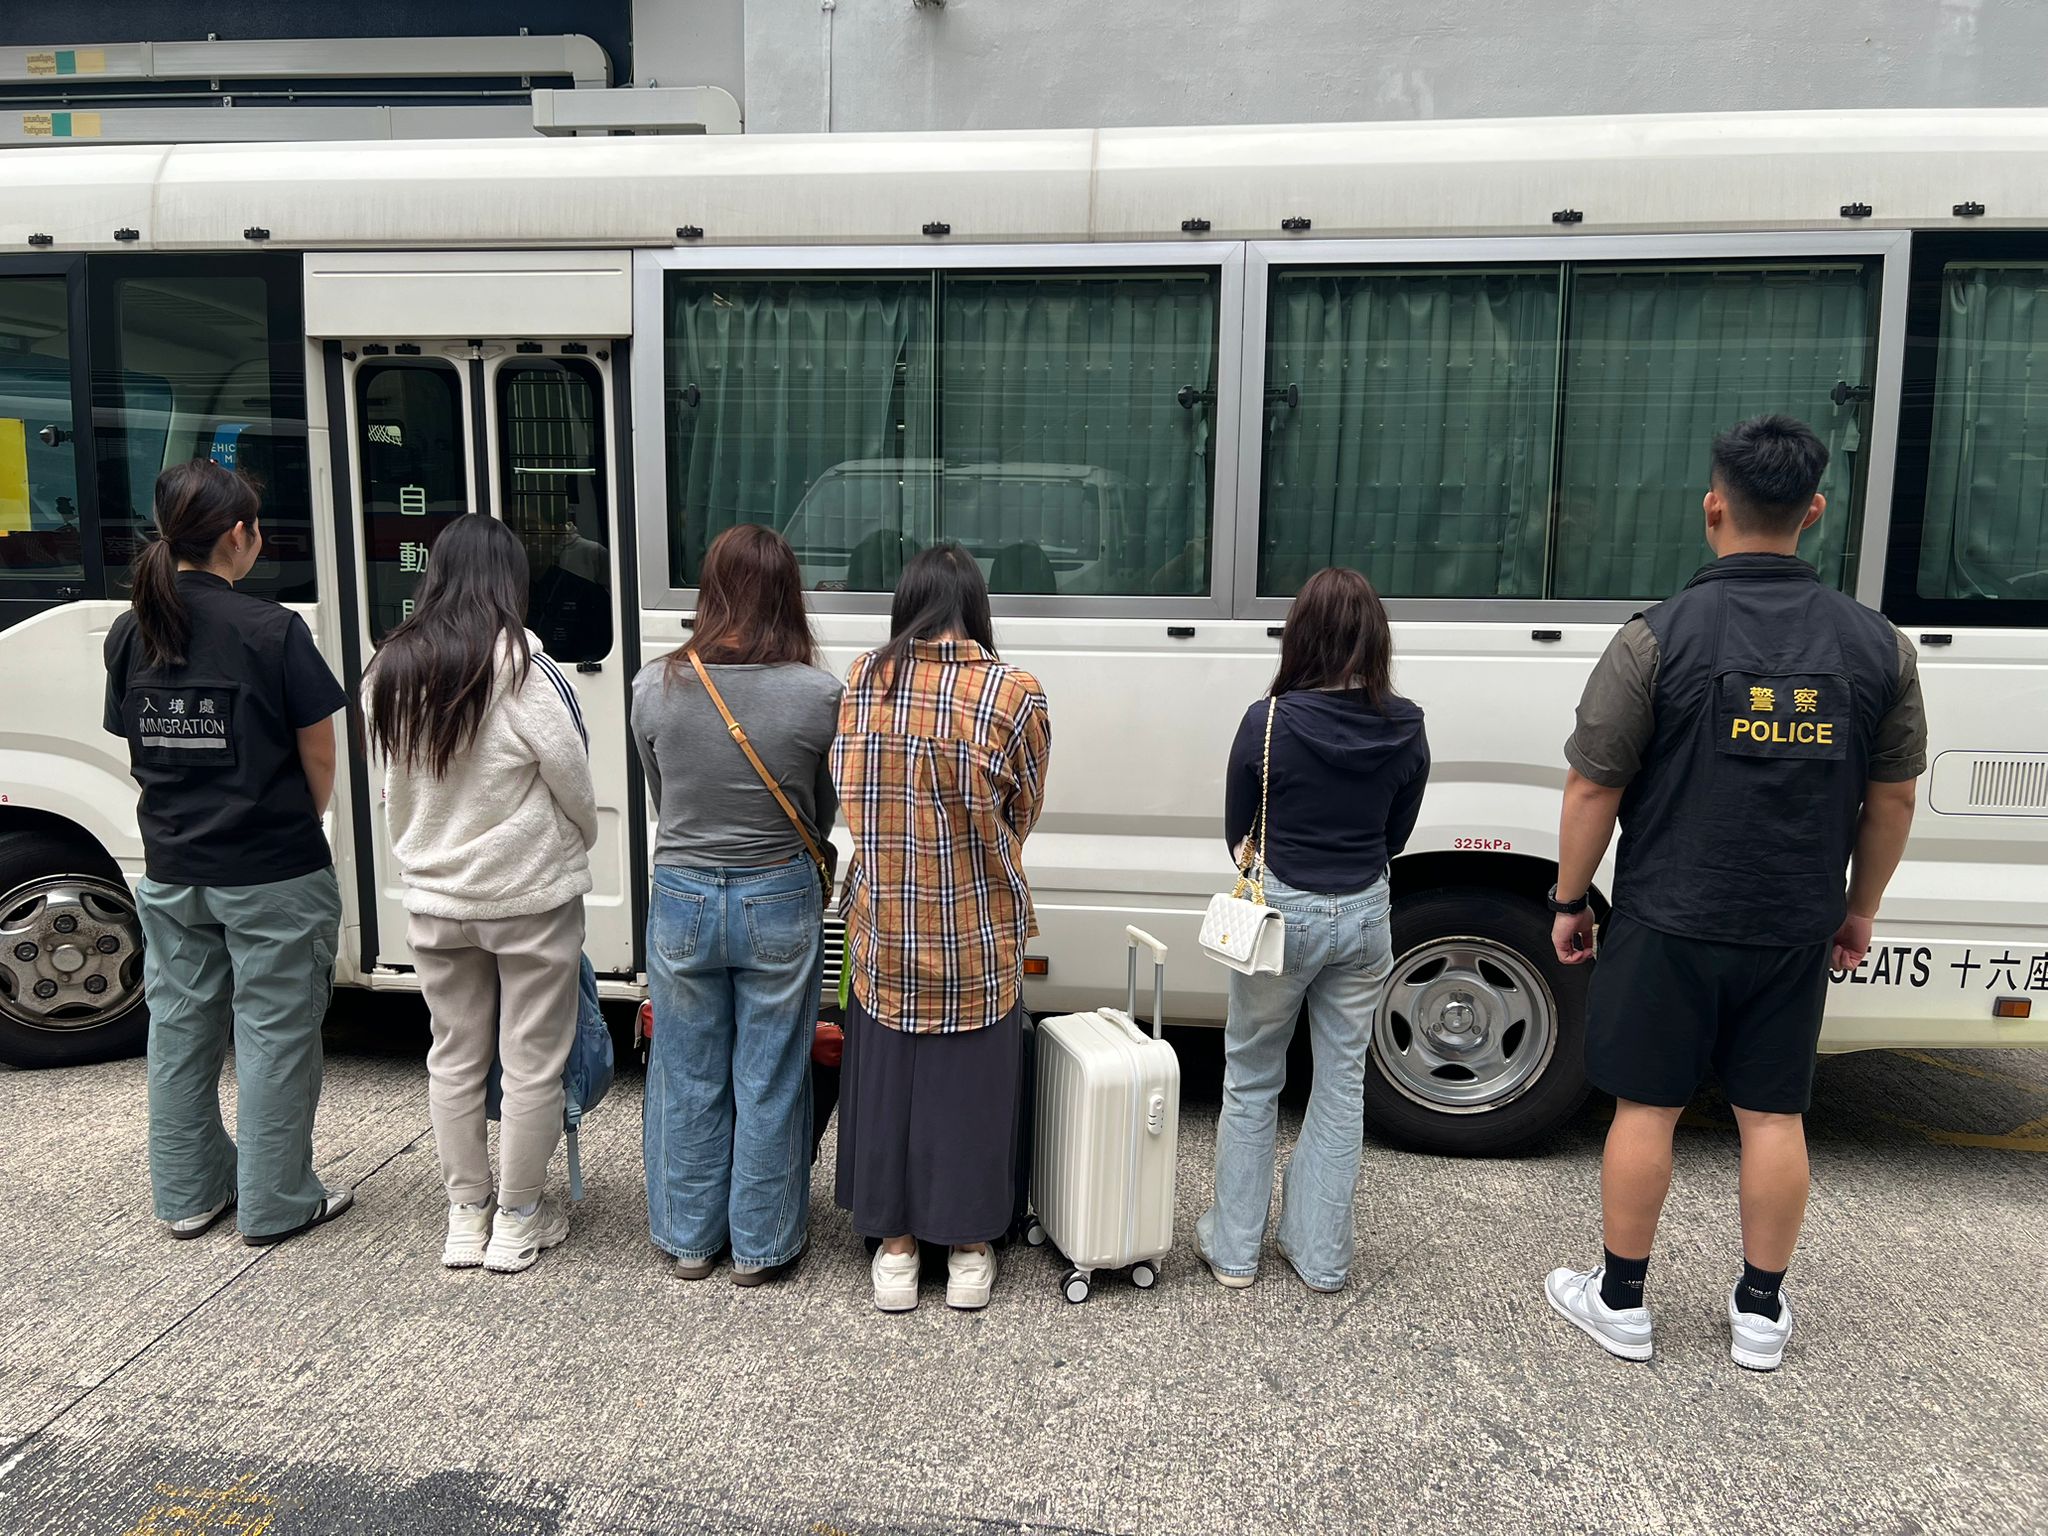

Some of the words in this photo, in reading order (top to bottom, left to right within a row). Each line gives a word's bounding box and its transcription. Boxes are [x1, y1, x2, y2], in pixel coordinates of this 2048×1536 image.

[142, 697, 215, 714] 入境處
[1749, 686, 1818, 713] 警察
[1731, 718, 1833, 744] POLICE
[1454, 838, 1511, 850] 325kPa
